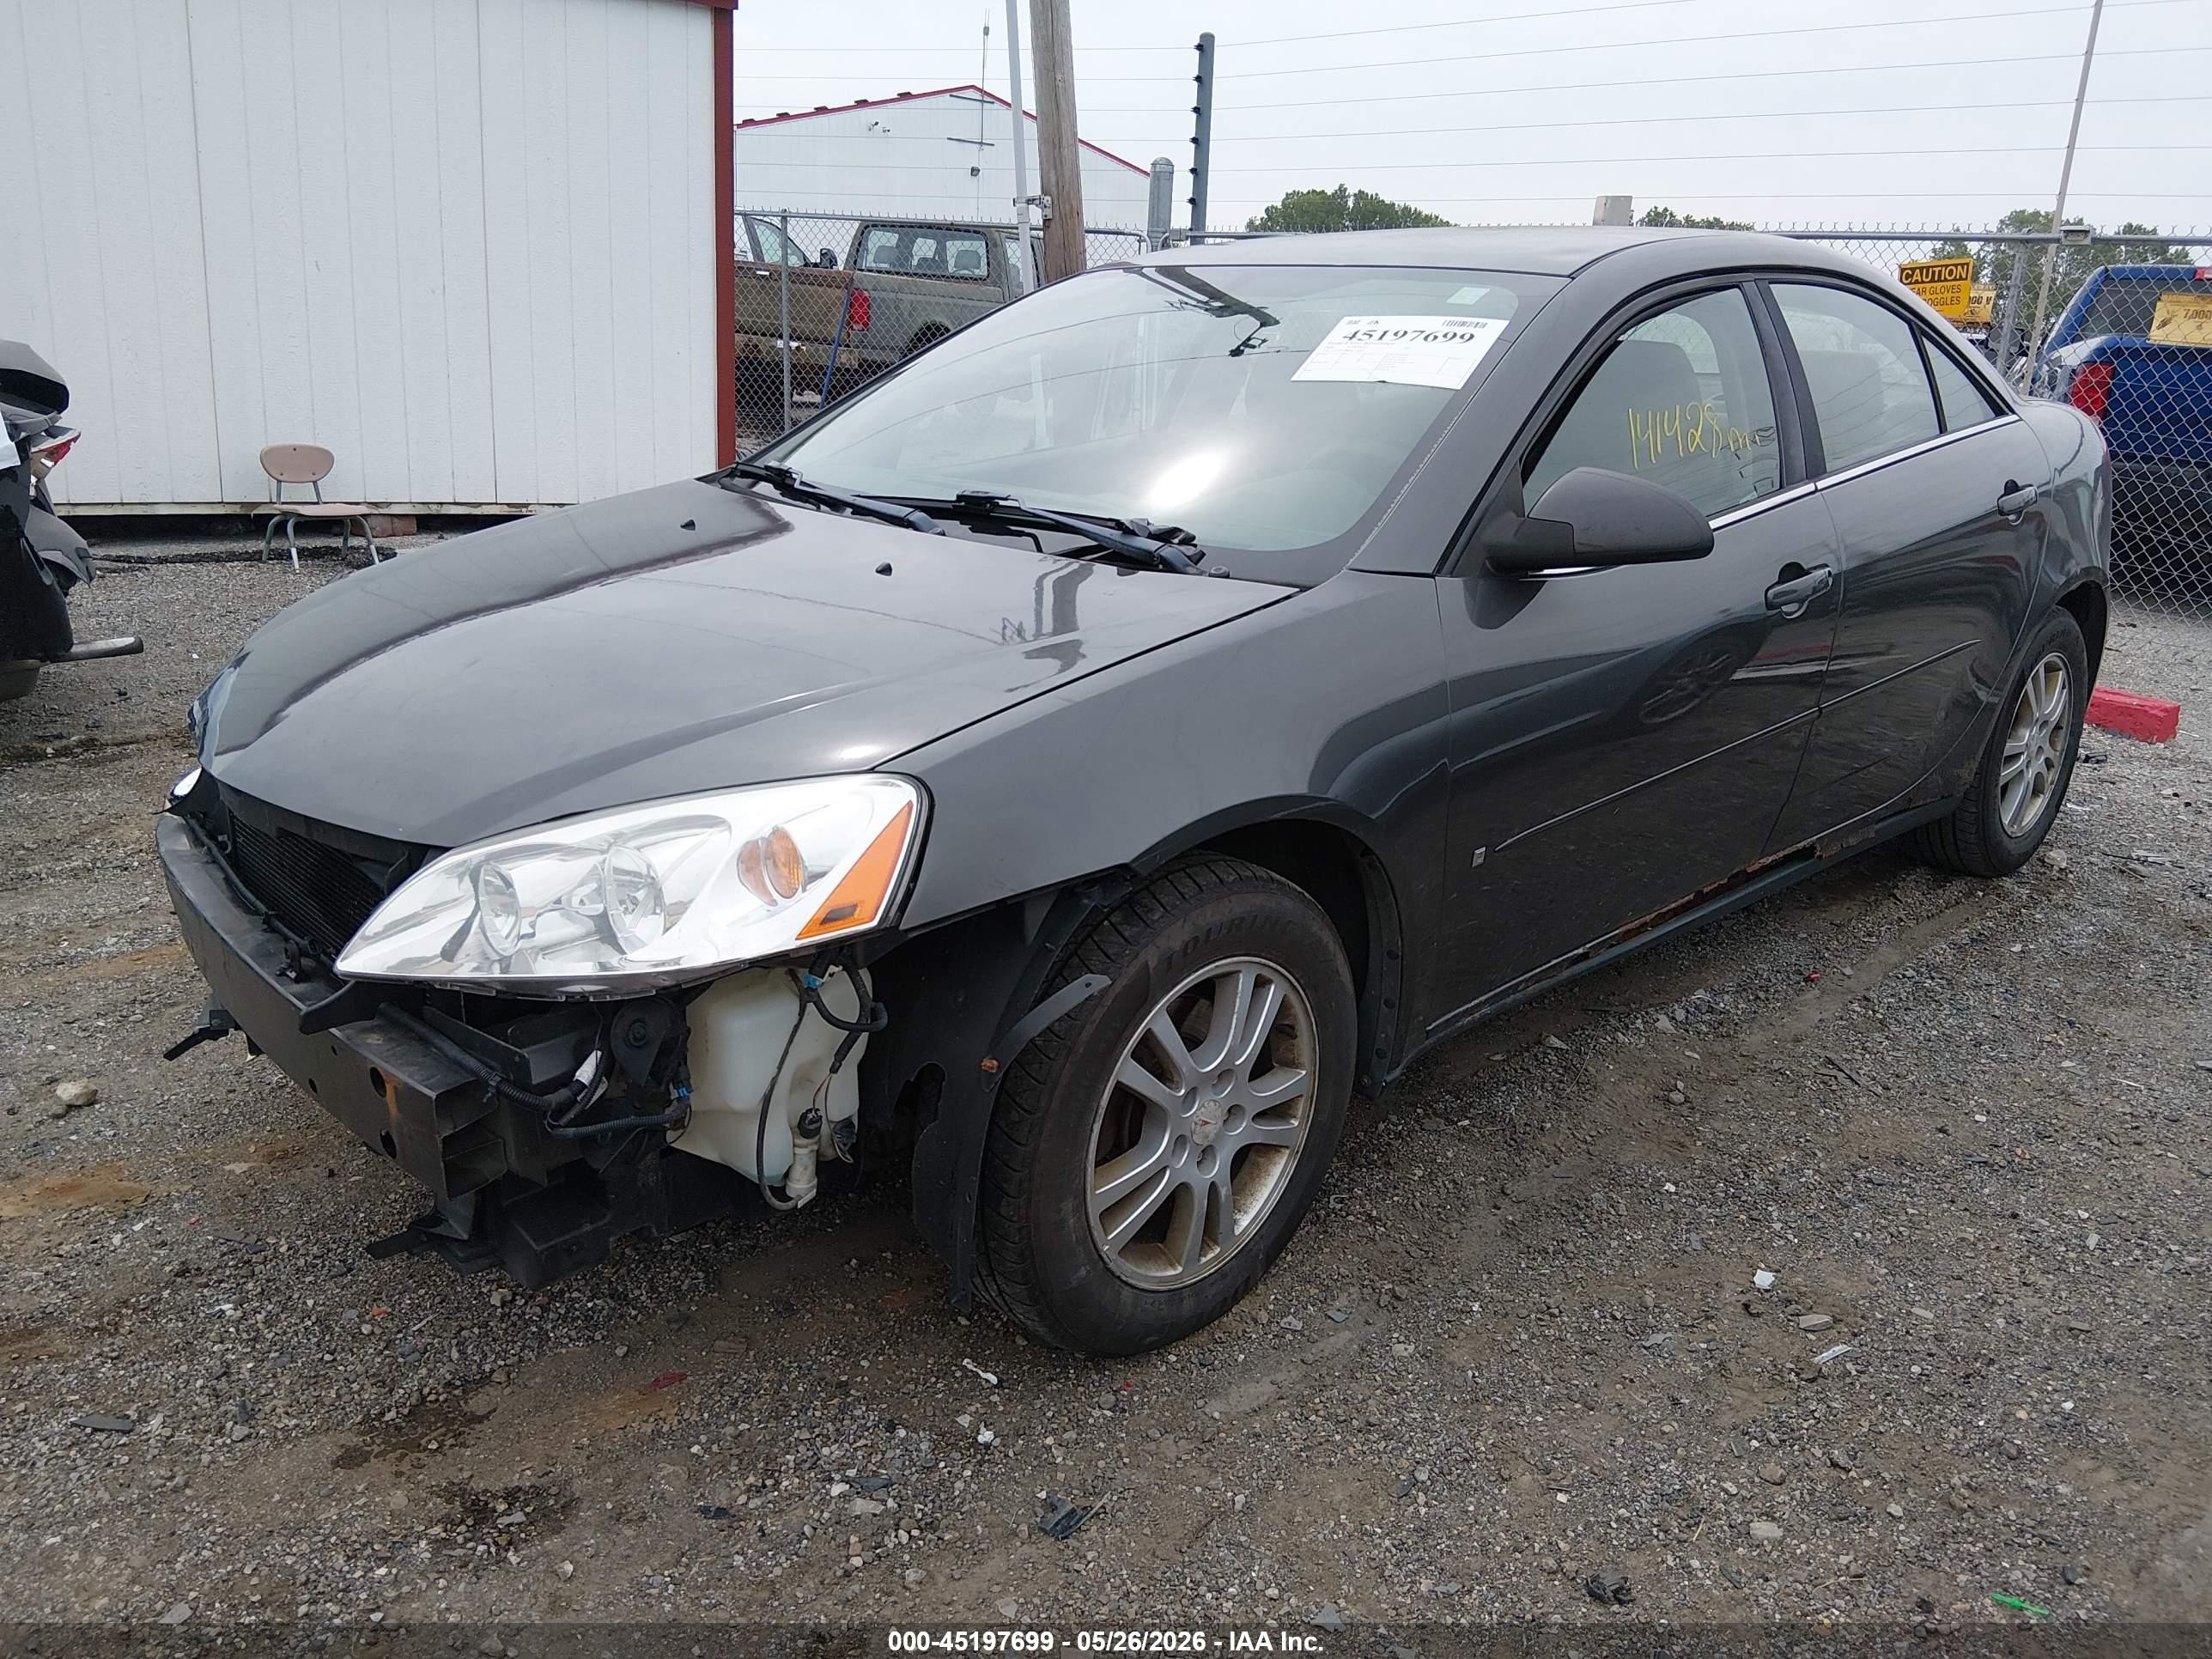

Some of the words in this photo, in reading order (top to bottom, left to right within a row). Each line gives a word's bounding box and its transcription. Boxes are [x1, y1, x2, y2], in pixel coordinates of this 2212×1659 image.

[1902, 264, 1967, 283] CAUTION
[1929, 283, 1962, 296] GLOVES
[1342, 328, 1475, 343] 45197699
